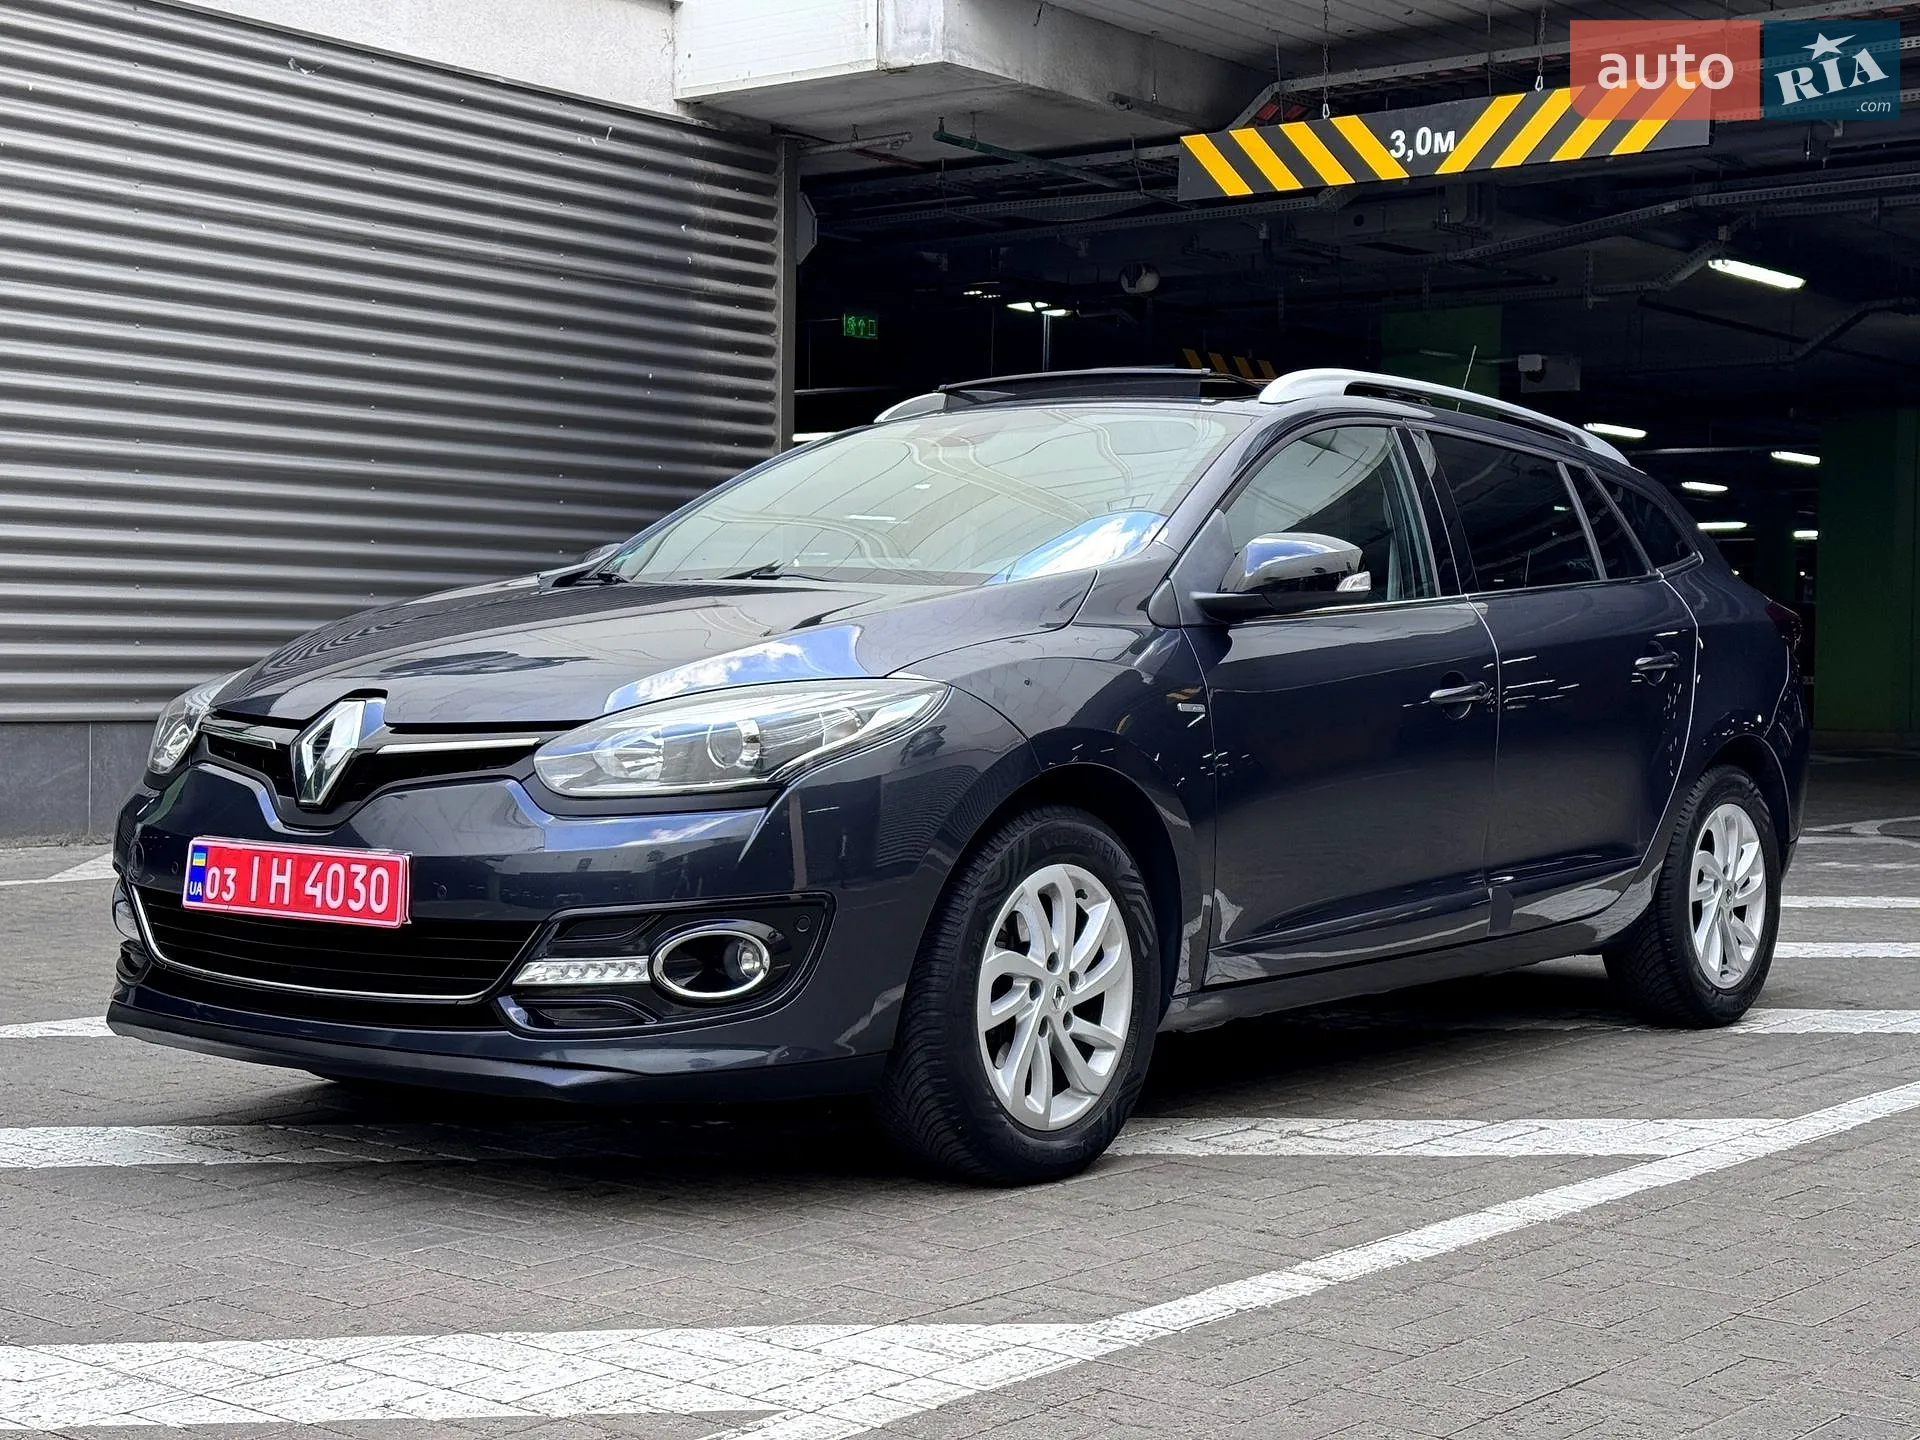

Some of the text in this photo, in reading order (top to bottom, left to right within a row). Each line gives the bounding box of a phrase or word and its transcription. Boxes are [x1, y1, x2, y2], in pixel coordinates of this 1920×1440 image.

[189, 881, 203, 896] UA
[205, 865, 237, 901] 03
[304, 861, 390, 914] 4030
